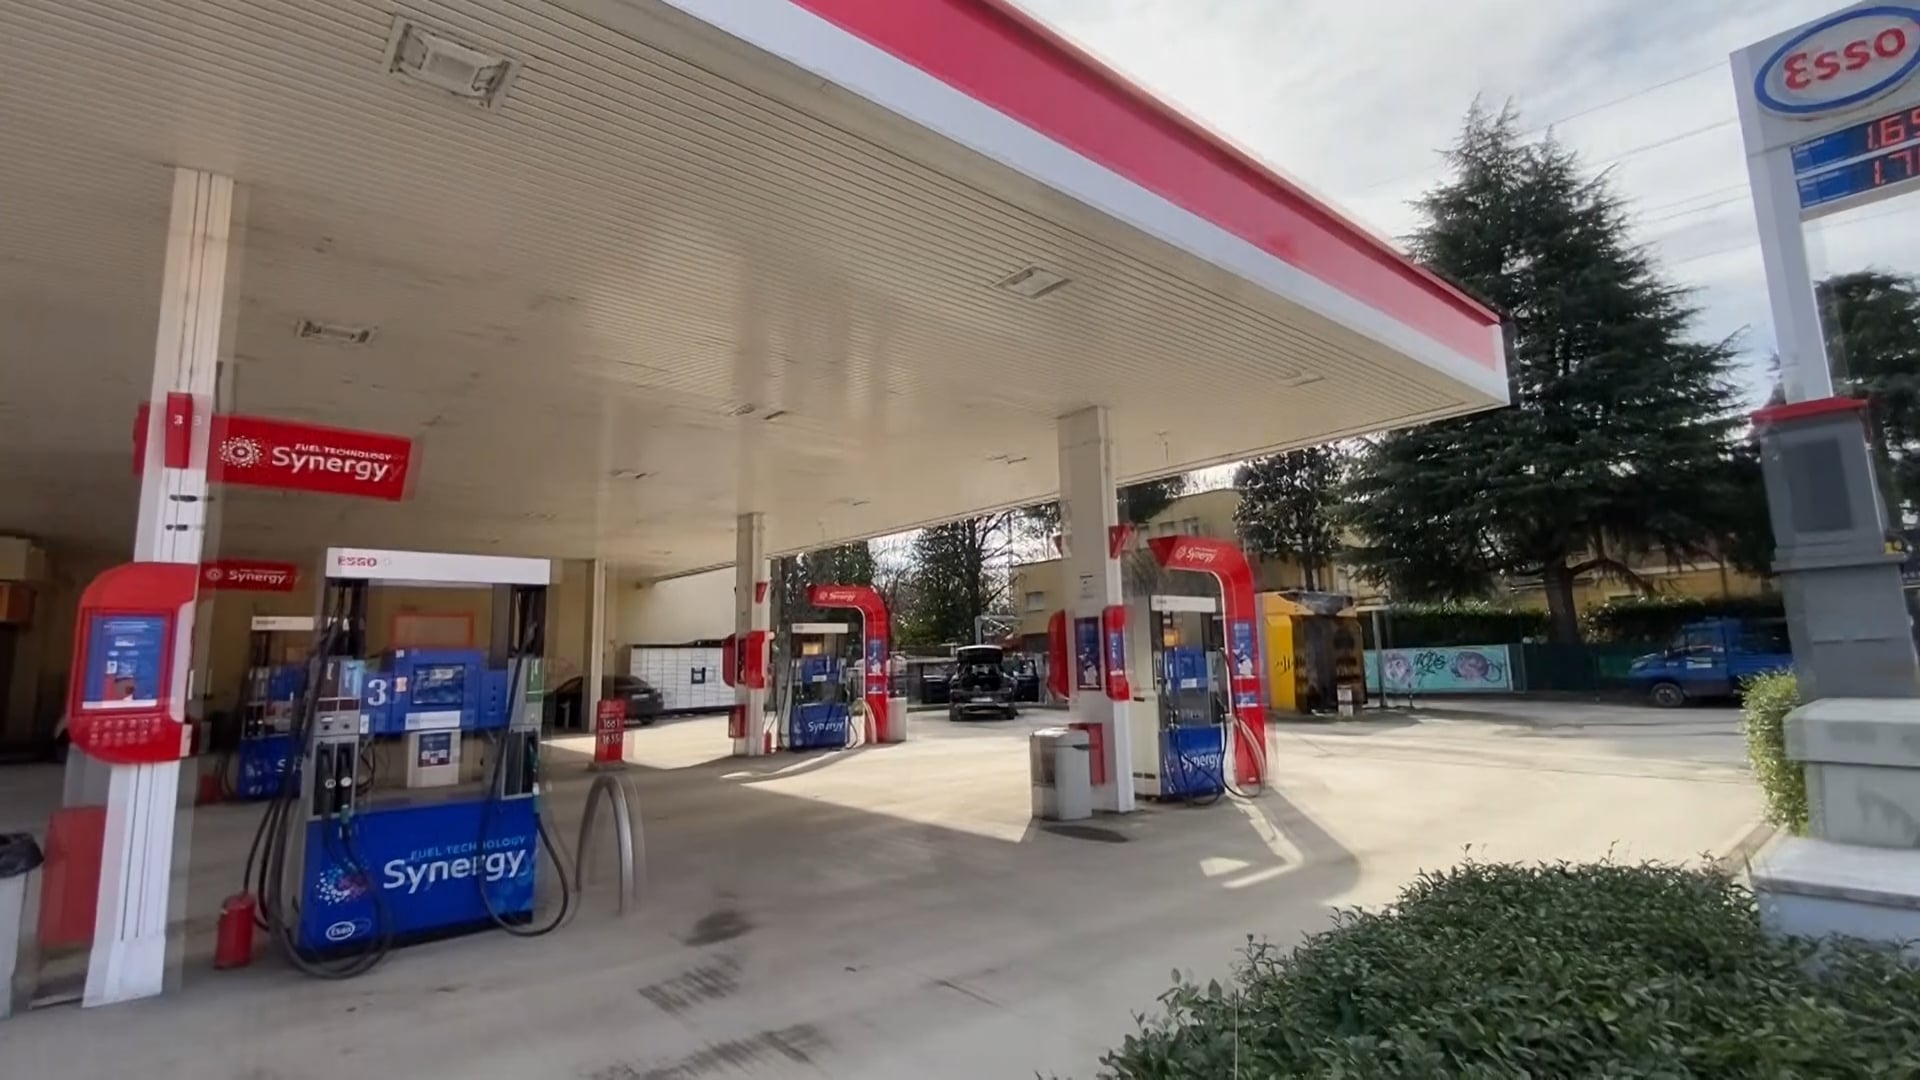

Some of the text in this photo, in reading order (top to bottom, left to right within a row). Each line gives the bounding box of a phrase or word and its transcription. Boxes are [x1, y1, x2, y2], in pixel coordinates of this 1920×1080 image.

[1874, 147, 1920, 184] 1.7
[272, 446, 390, 482] Synergy
[295, 443, 392, 461] FUEL TECHNOLOGY
[228, 569, 287, 585] Synergy
[367, 679, 387, 706] 3
[410, 848, 442, 861] FUEL
[383, 849, 526, 894] Synergy
